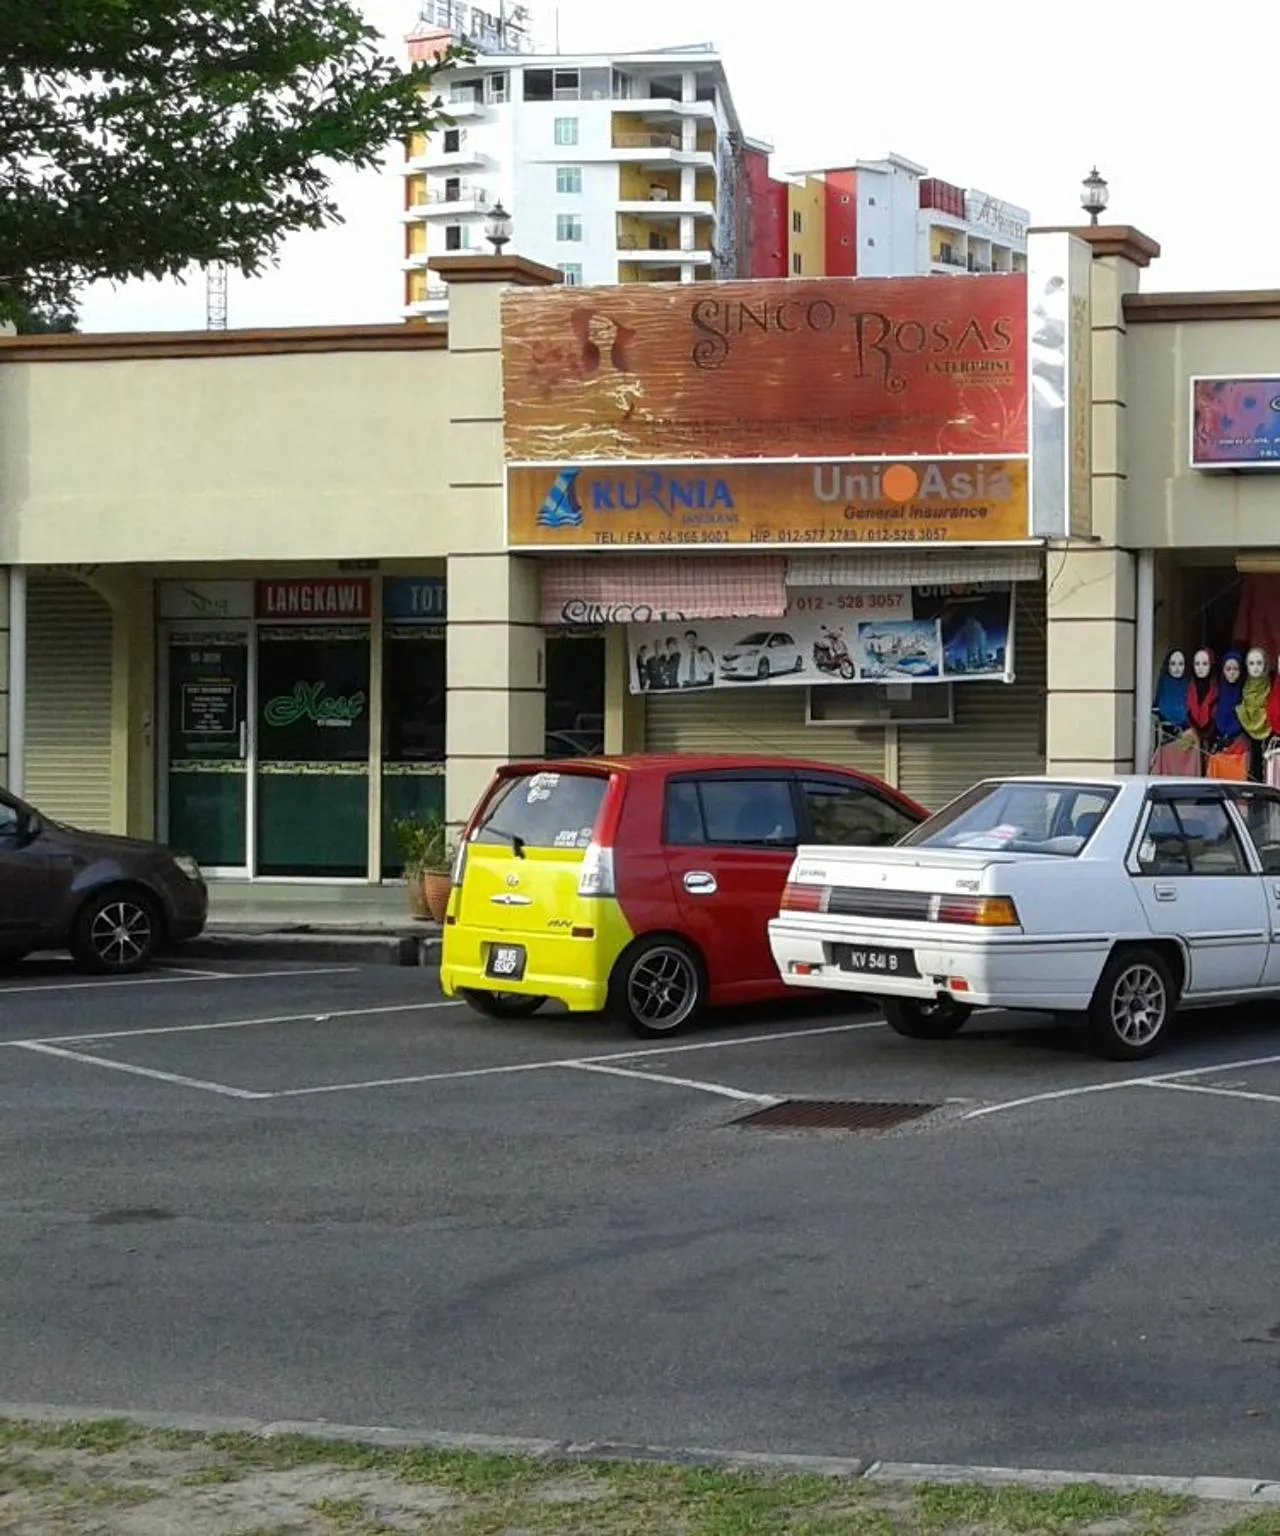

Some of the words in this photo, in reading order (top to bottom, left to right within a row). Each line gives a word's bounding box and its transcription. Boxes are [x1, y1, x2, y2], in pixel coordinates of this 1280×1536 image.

[691, 298, 836, 370] SINCO
[852, 311, 1013, 393] ROSAS
[592, 468, 735, 518] KURNIA
[843, 505, 904, 520] General
[908, 505, 988, 520] Insurance
[267, 584, 363, 613] LANGKAWI
[797, 597, 824, 611] 012
[836, 596, 863, 610] 528
[868, 594, 904, 609] 3057
[851, 951, 867, 968] KV
